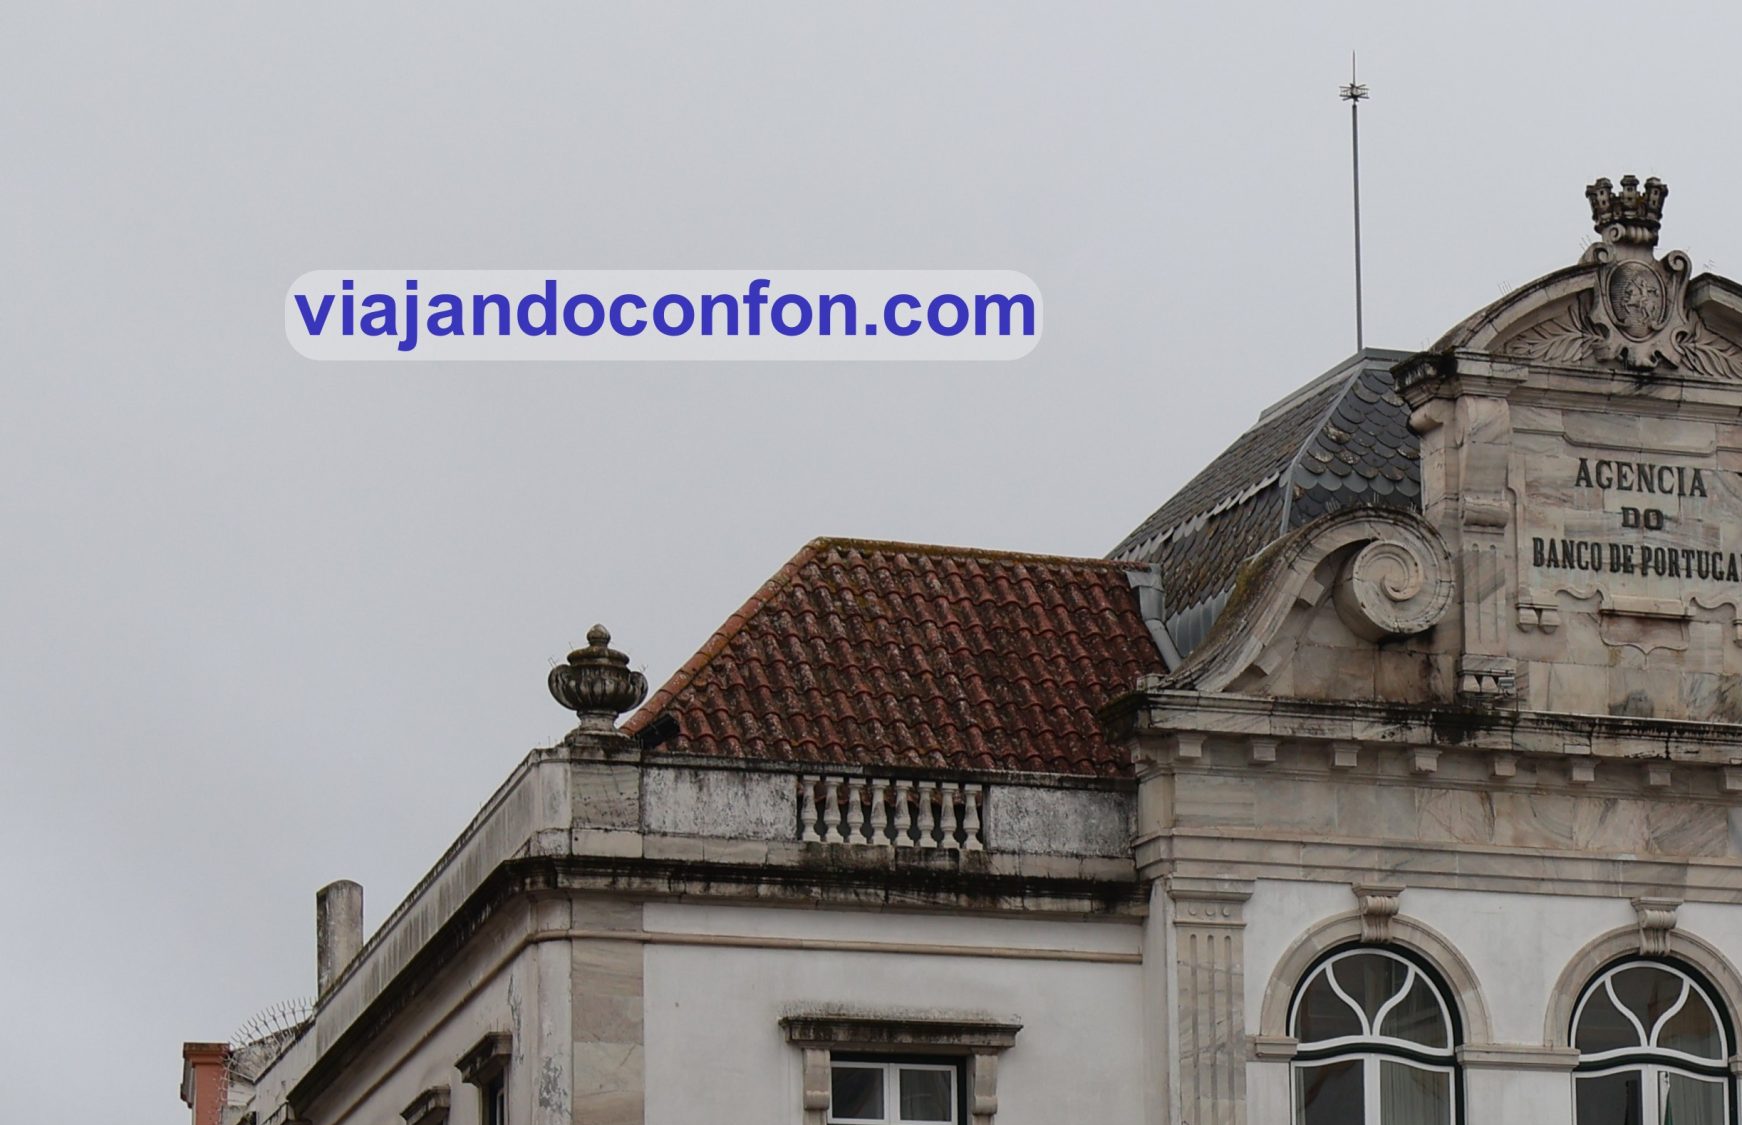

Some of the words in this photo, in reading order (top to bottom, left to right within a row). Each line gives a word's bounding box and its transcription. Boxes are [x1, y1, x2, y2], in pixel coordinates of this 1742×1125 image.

[1575, 457, 1708, 498] AGENCIA
[1621, 506, 1664, 531] DO
[1532, 537, 1601, 572] BANCO
[1609, 544, 1635, 575] DE
